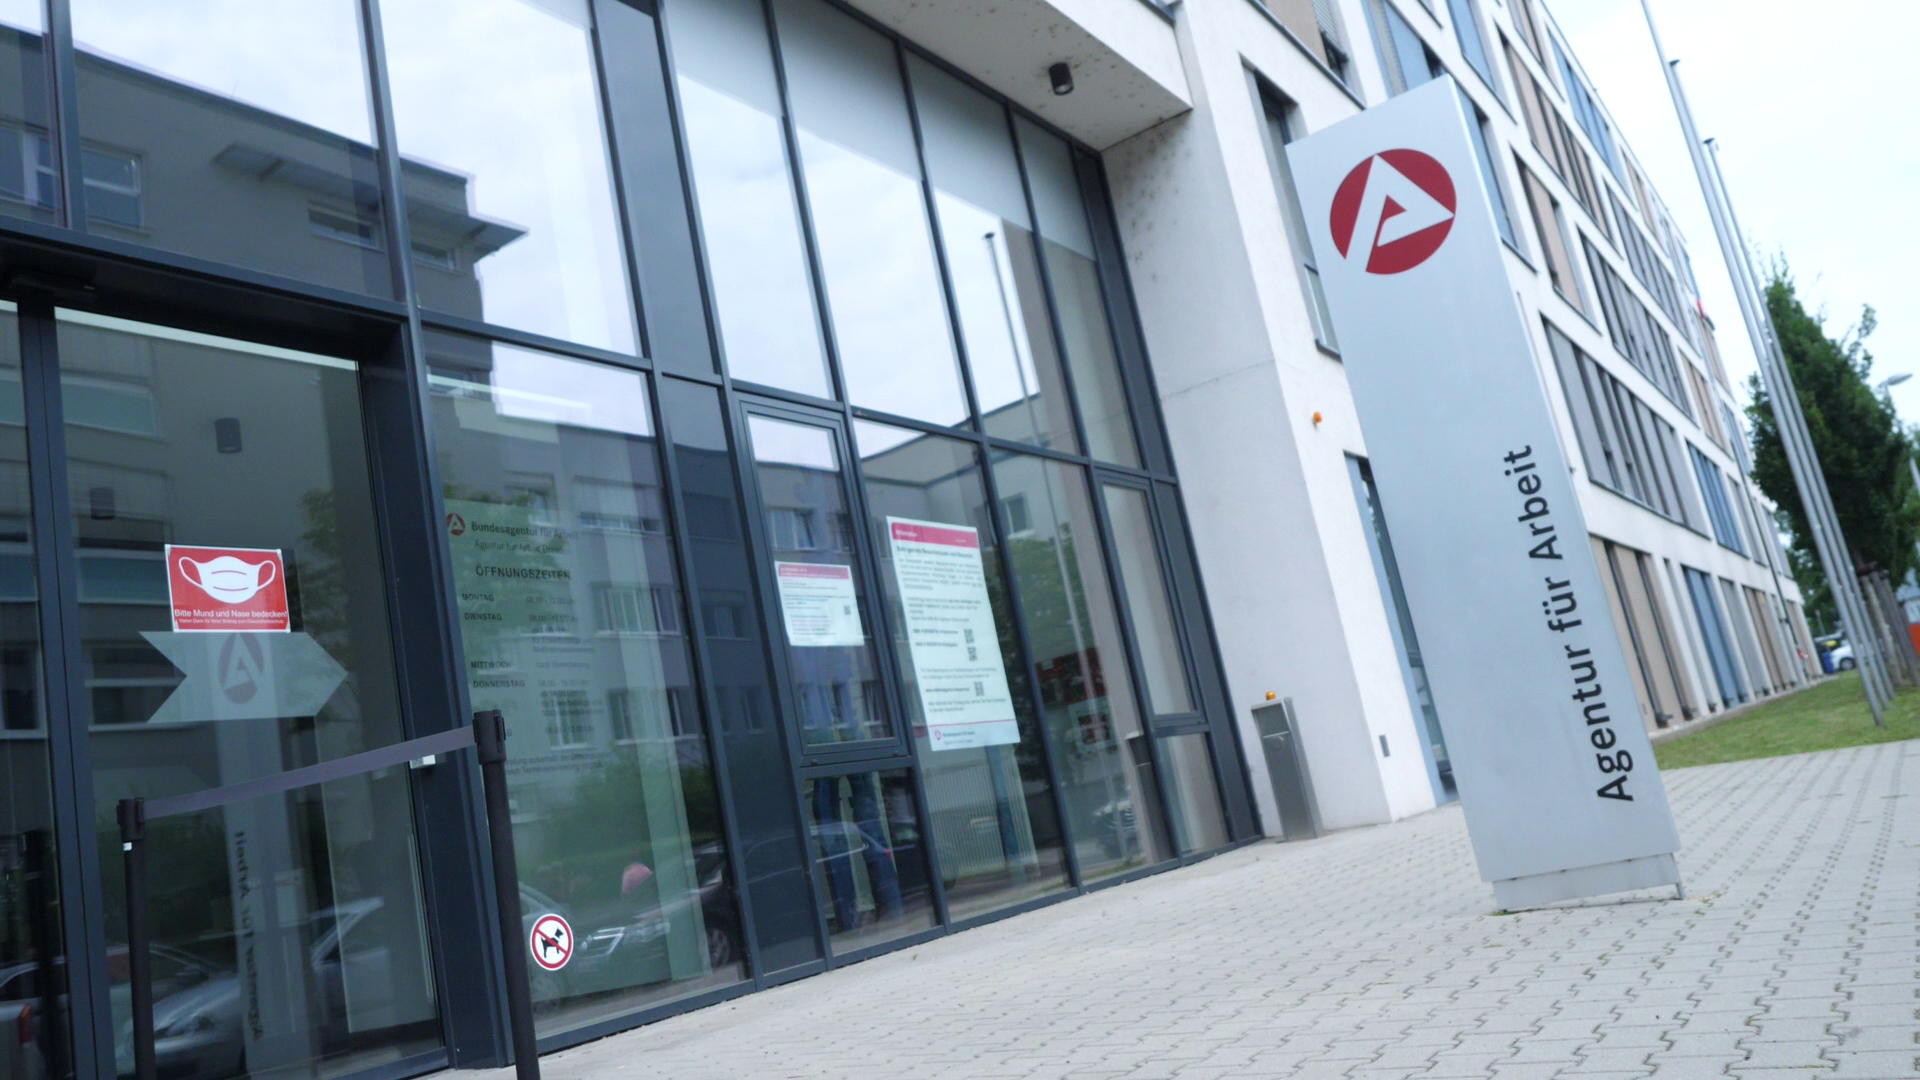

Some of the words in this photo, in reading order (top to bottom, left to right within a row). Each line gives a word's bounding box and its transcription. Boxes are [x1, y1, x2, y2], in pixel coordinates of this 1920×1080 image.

[1504, 445, 1563, 560] Arbeit
[471, 521, 538, 537] Bundesagentur
[475, 564, 571, 580] ÖFFNUNGSZEITEN
[461, 593, 495, 602] MONTAG
[1542, 576, 1582, 632] für
[174, 609, 192, 617] Bitte
[193, 609, 214, 617] Mund
[464, 612, 503, 621] DIENSTAG
[470, 661, 512, 669] MITTWOCH
[473, 679, 526, 689] DONNERSTAG
[1564, 645, 1634, 802] Agentur
